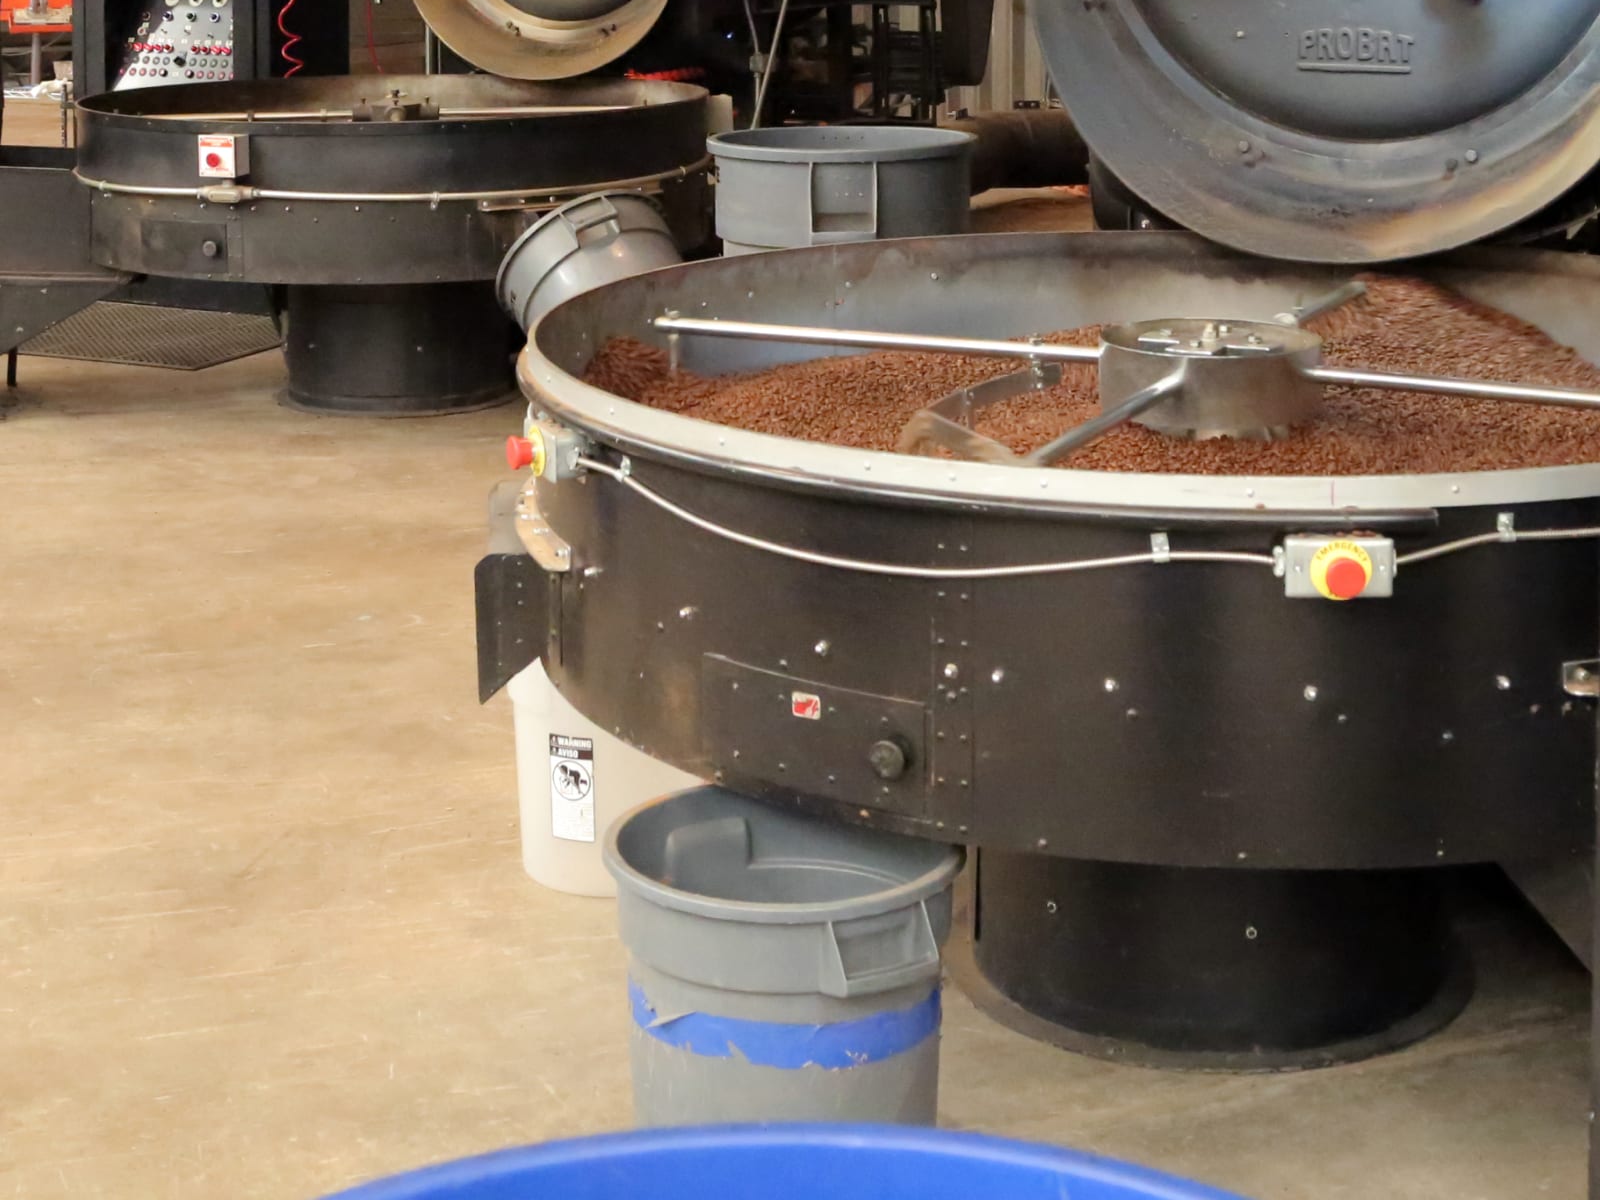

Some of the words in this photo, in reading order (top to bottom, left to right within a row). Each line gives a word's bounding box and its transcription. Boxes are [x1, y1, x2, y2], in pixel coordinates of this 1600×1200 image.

[1298, 26, 1414, 63] PROBAT
[1316, 542, 1368, 561] EMERGENCY
[557, 736, 592, 749] WARNING
[557, 747, 579, 759] AVISO
